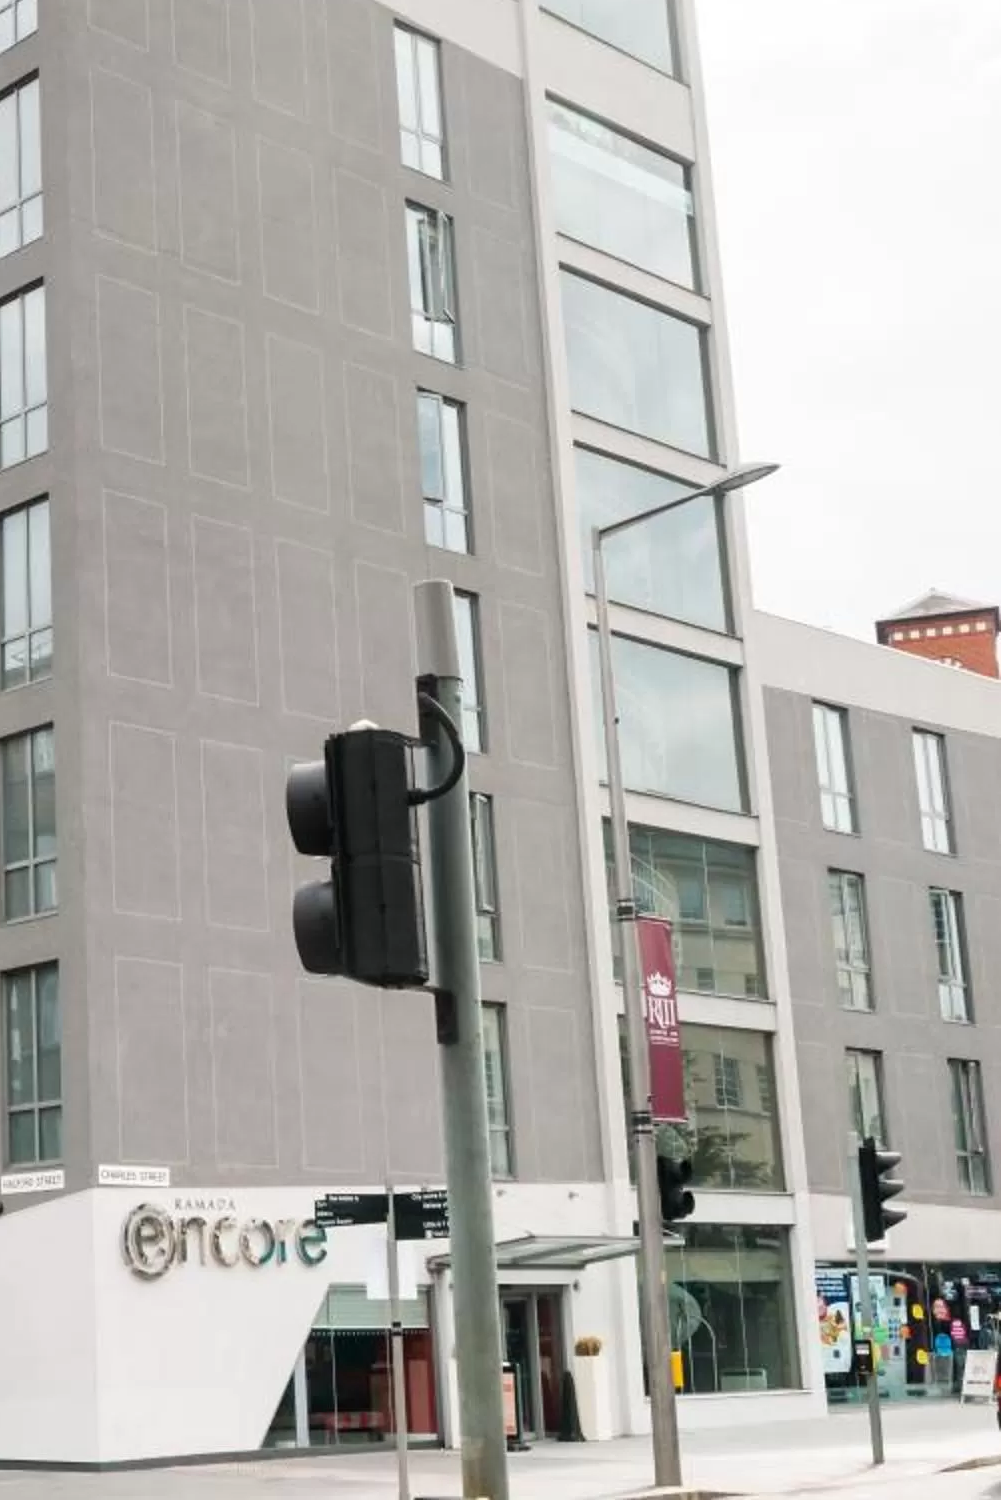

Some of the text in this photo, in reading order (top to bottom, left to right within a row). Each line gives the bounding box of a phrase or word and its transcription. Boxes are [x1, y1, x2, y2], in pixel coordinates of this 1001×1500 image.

[35, 1173, 63, 1187] STREET
[139, 1171, 167, 1182] STREET
[174, 1198, 237, 1211] RAMADA
[121, 1202, 328, 1281] encore
